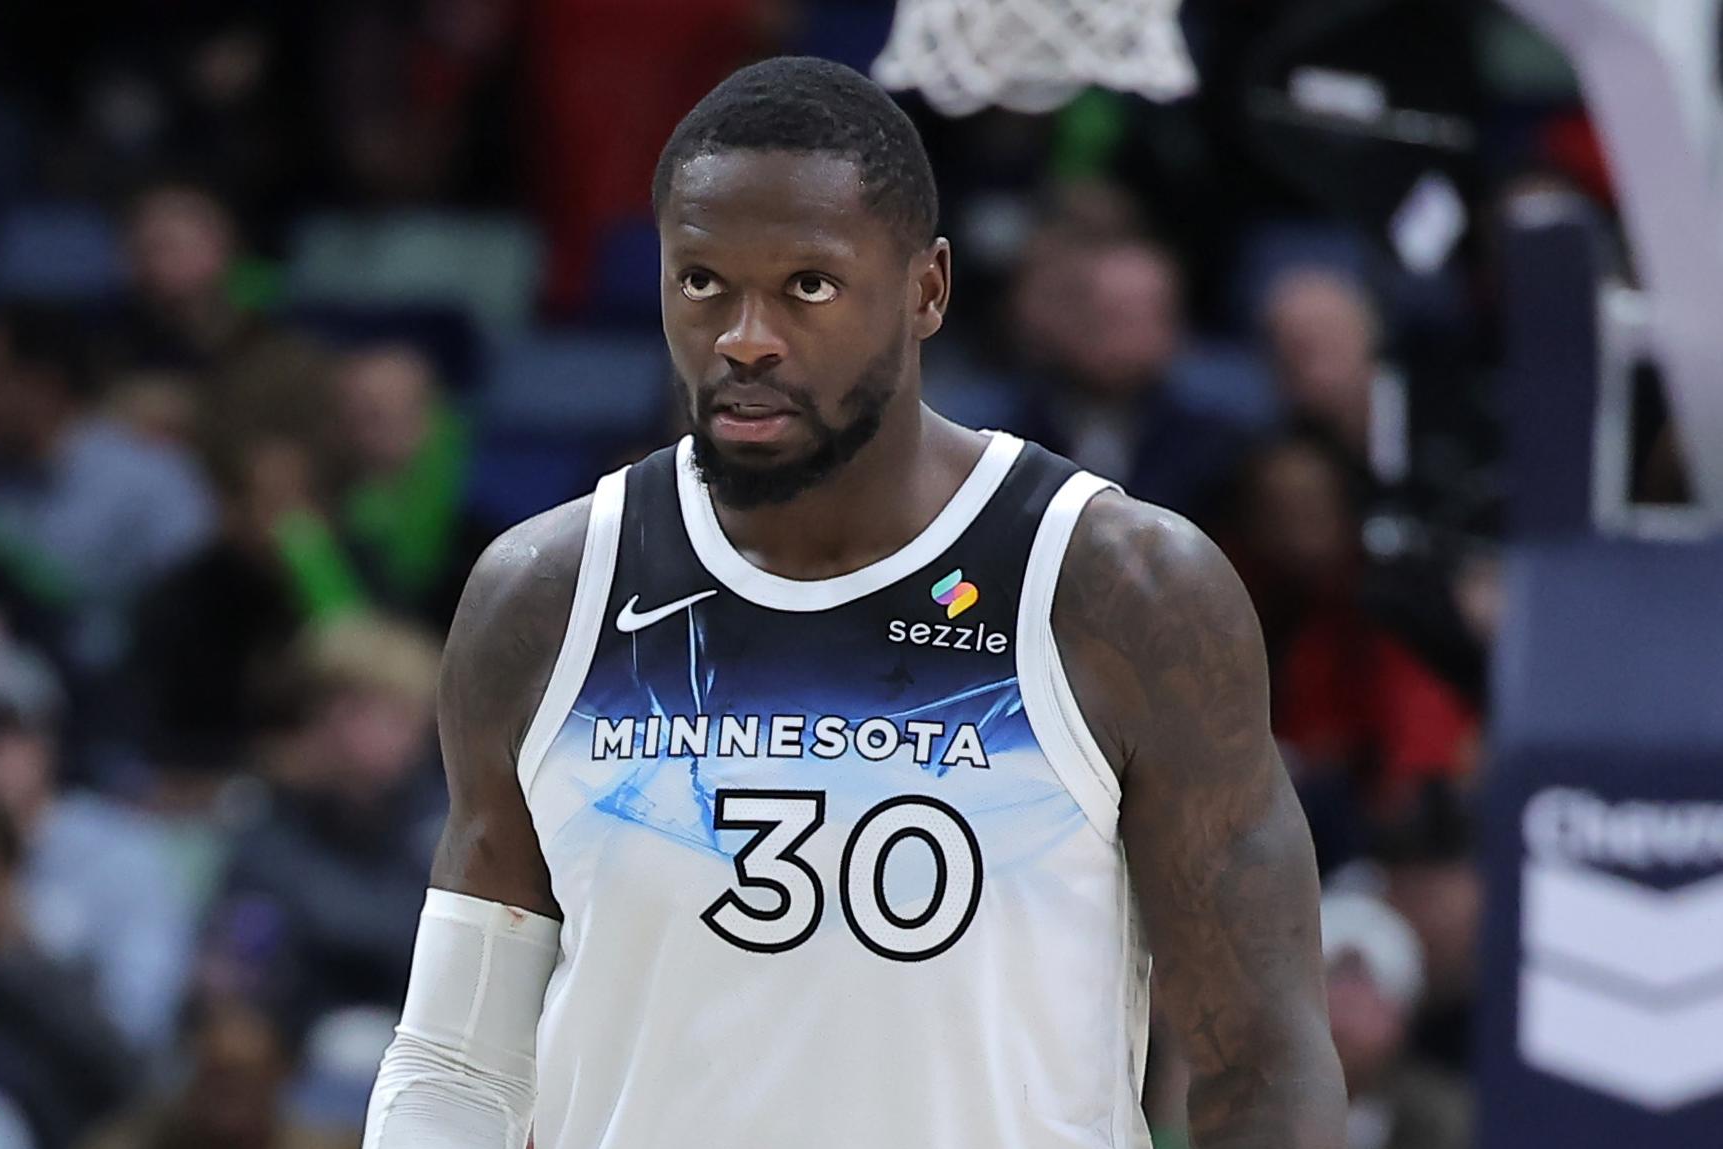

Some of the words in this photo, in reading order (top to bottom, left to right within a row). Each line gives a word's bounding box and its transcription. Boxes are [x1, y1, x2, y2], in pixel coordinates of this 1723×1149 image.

[888, 618, 1008, 655] sezzle
[590, 713, 991, 769] MINNESOTA
[700, 788, 984, 963] 30
